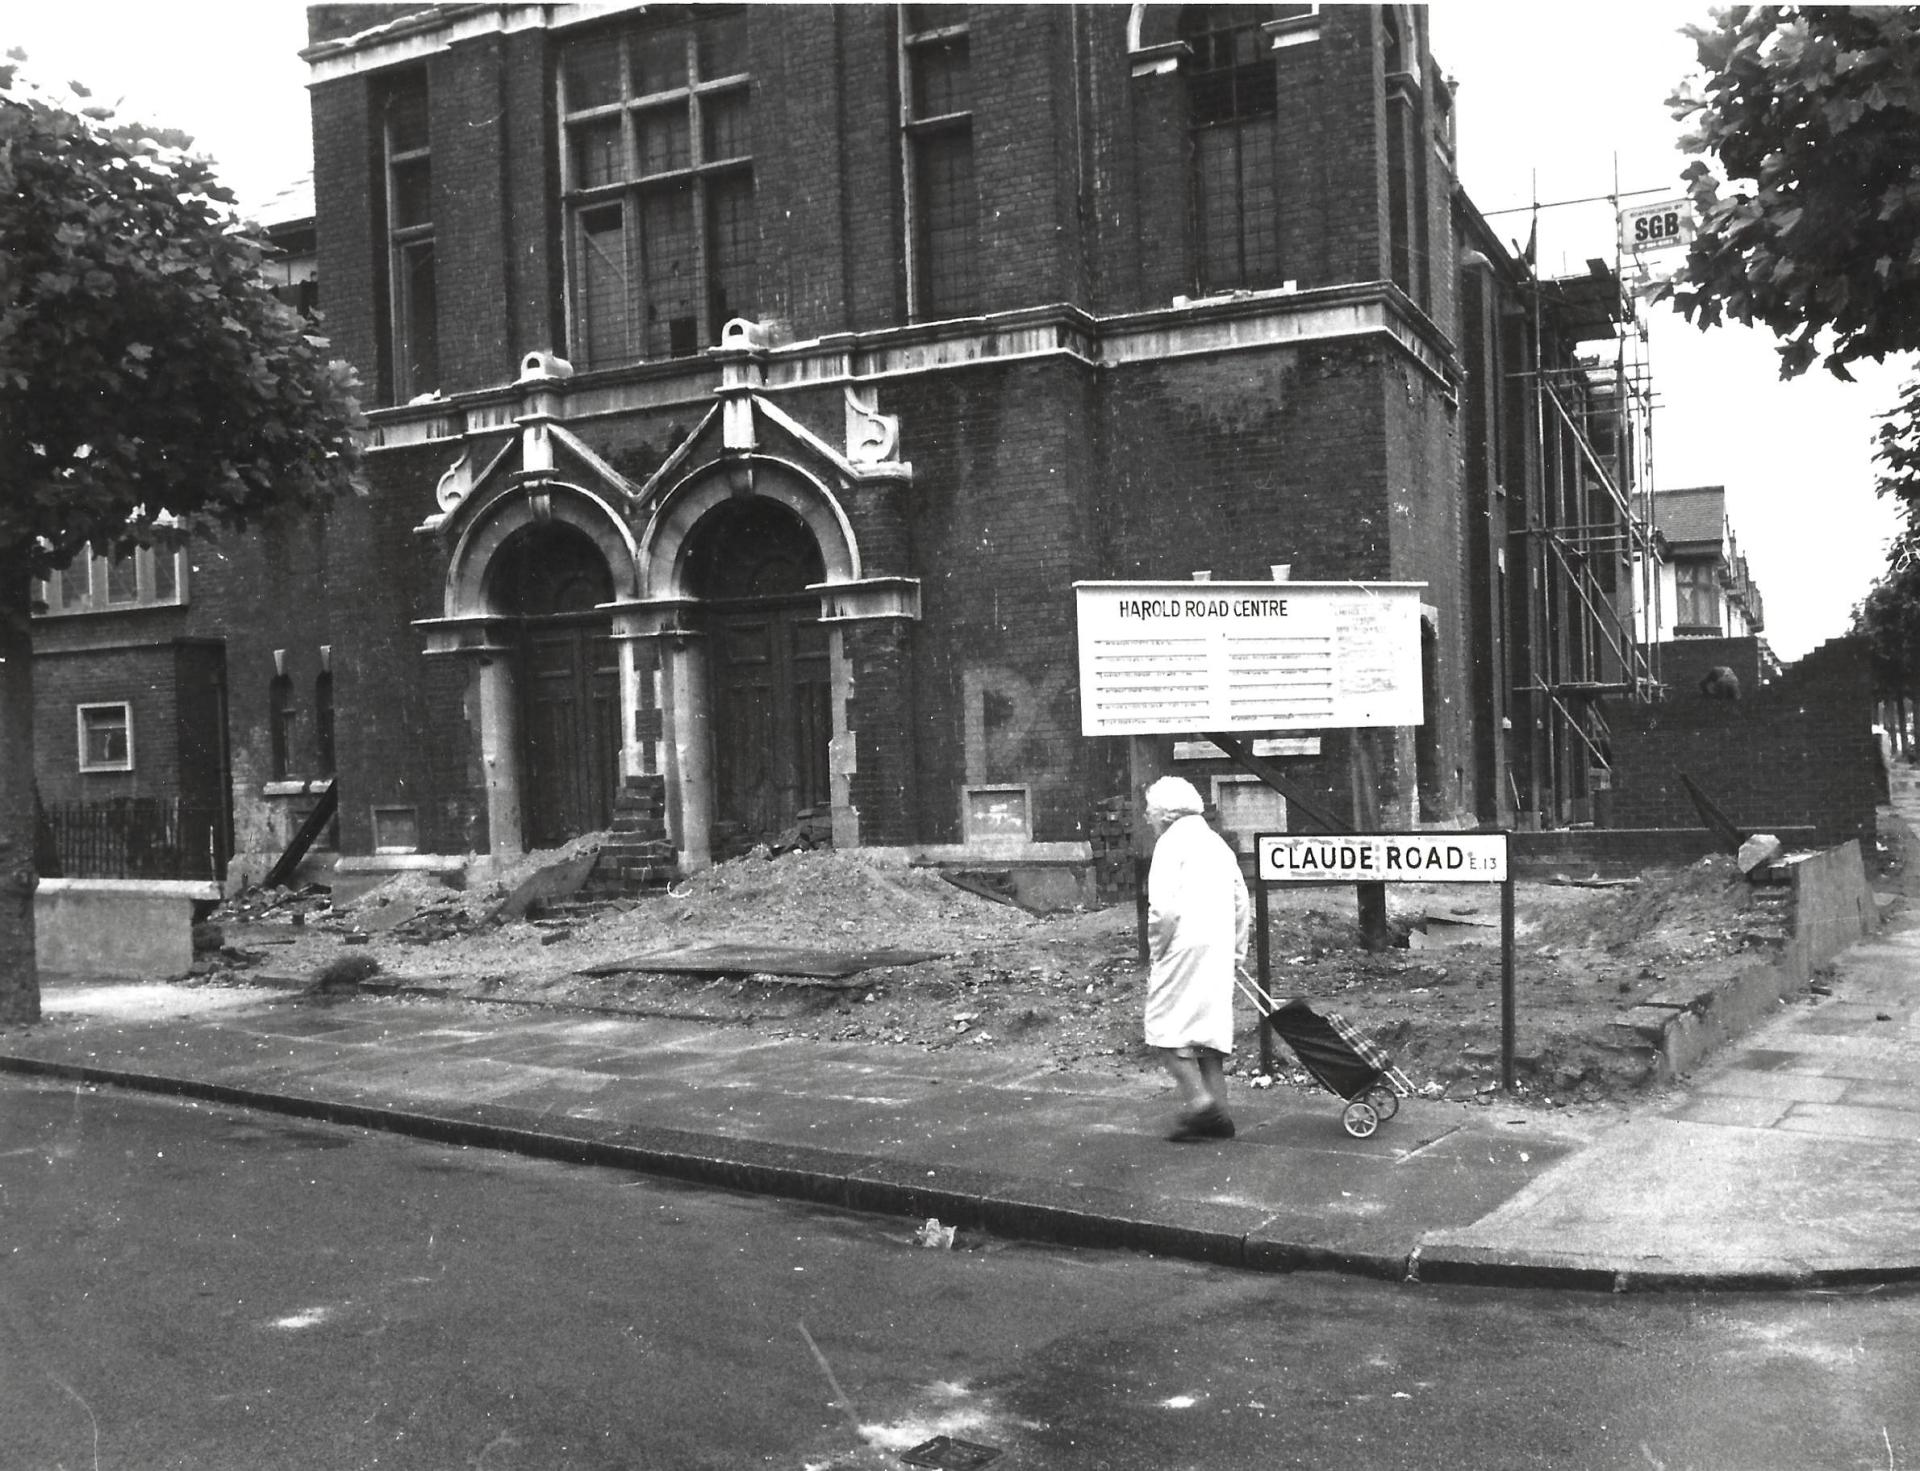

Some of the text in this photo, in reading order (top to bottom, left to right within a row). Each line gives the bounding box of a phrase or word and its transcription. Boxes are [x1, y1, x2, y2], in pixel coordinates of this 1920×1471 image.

[1635, 212, 1680, 242] SGB
[1119, 599, 1289, 619] HAROLD ROAD CENTRE
[1270, 846, 1497, 871] CLAUDE ROAD E.13
